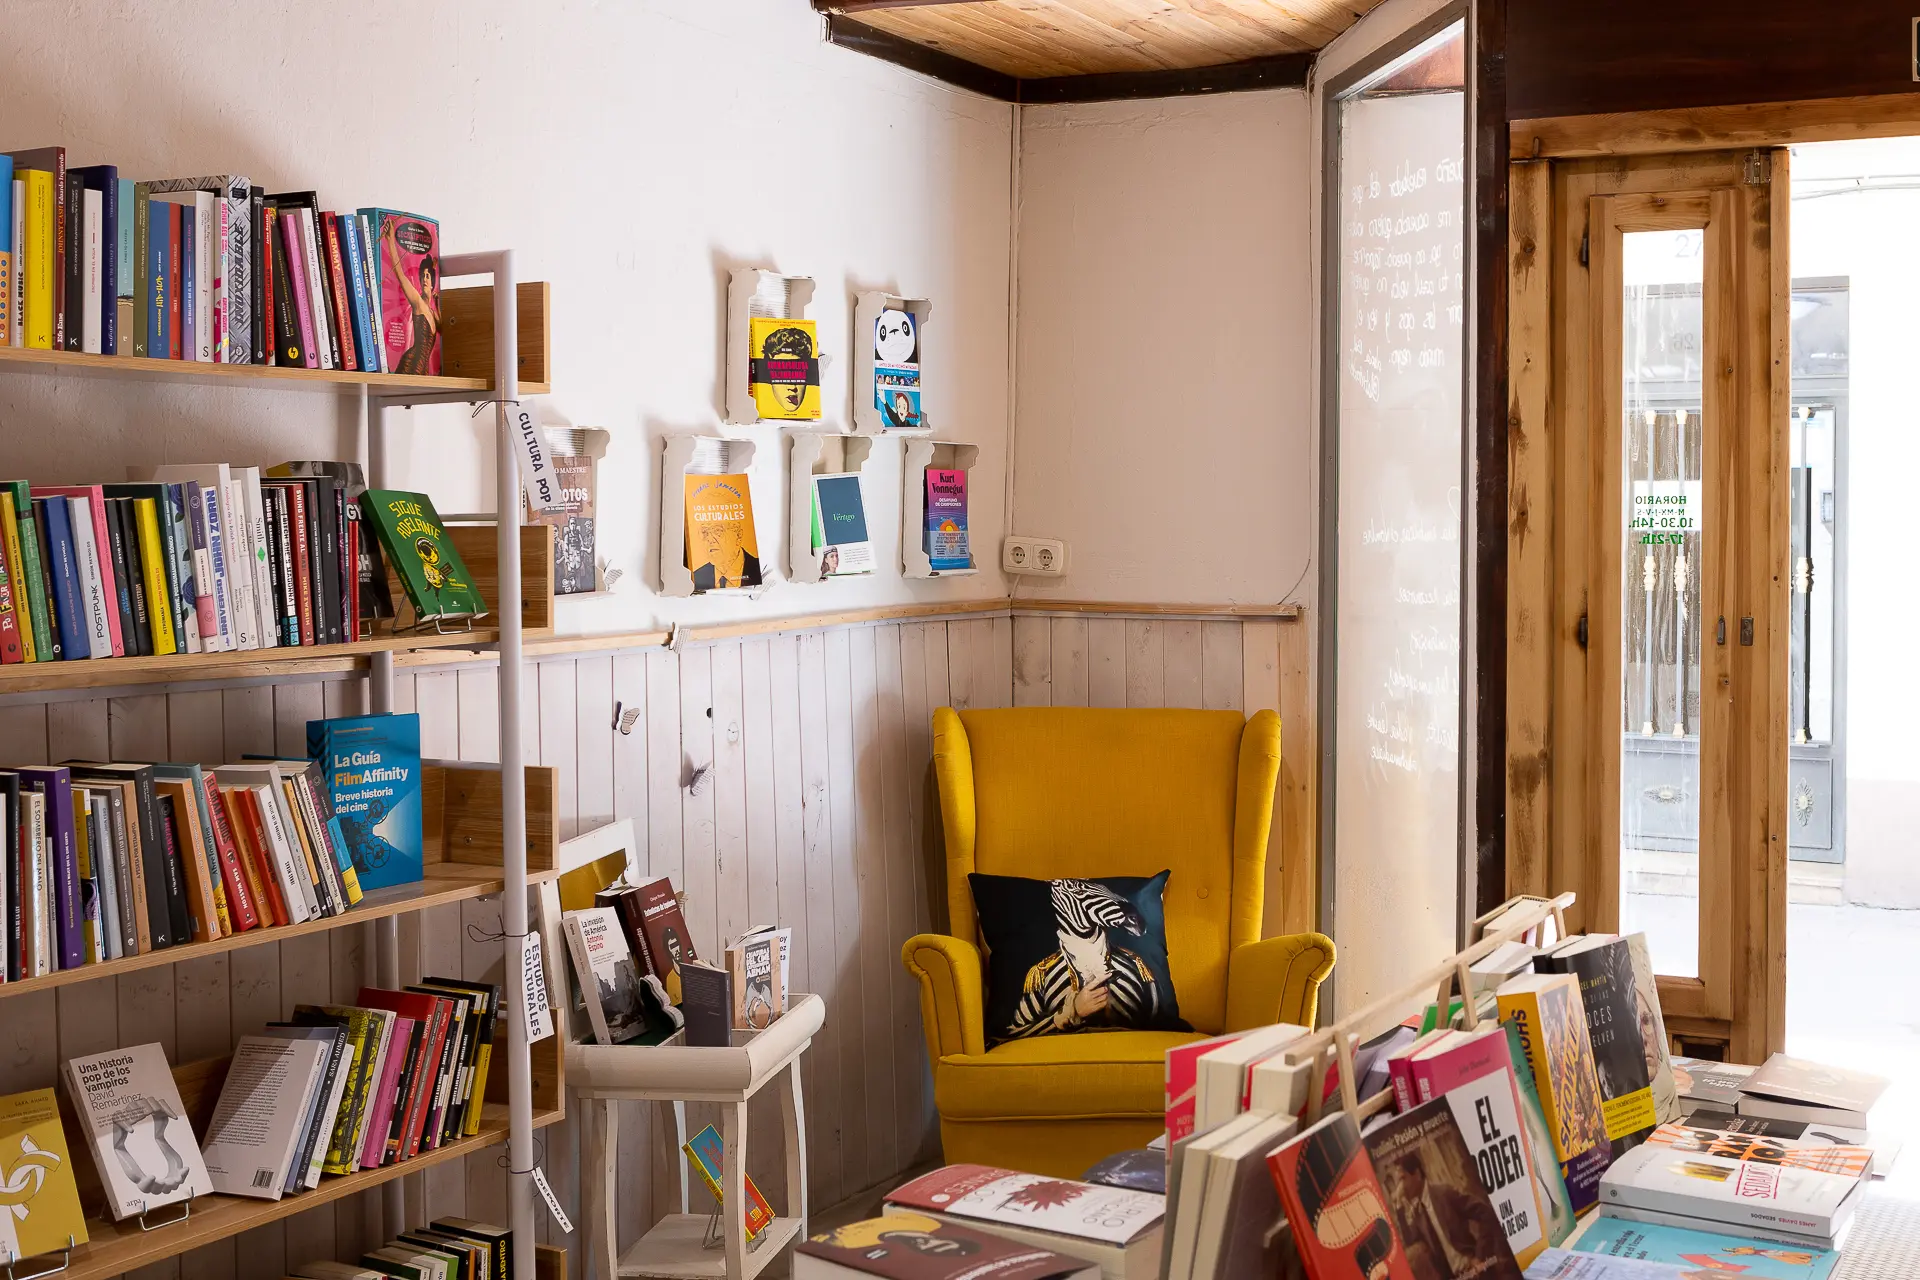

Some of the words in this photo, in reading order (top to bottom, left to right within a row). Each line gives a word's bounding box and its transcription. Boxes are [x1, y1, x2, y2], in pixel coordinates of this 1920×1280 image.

[347, 219, 356, 249] FARGO
[330, 231, 340, 271] LEMMY
[352, 250, 360, 276] ROCK
[234, 222, 244, 325] INOXIDABLE
[354, 276, 364, 299] CITY
[518, 412, 544, 473] CULTURA
[536, 478, 552, 503] POP
[939, 472, 955, 483] Kurt
[932, 482, 964, 496] Vonnegut
[205, 490, 220, 533] ZORN
[388, 500, 423, 518] SIGUE
[694, 511, 745, 522] CULTURALES
[396, 517, 441, 540] ADELANTE
[211, 535, 224, 578] JOHN
[299, 543, 306, 552] AL
[90, 585, 104, 638] POSTPUNK
[214, 578, 228, 636] UNIVERSO
[334, 754, 350, 768] La
[351, 750, 381, 766] Guía
[206, 778, 214, 787] EL
[335, 766, 409, 787] FilmAffinity
[34, 800, 40, 808] EL
[210, 787, 224, 816] GRAN
[335, 792, 360, 803] Breve
[361, 786, 393, 800] historia
[308, 780, 323, 820] SCREAM
[320, 822, 333, 854] QUEER
[335, 803, 349, 814] del
[350, 802, 368, 812] cine
[34, 810, 42, 851] SOMBRERO
[205, 826, 214, 844] ojos
[216, 815, 231, 844] ADIÓS
[208, 845, 216, 857] los
[210, 857, 218, 875] Abre
[236, 882, 248, 910] WASSON
[580, 920, 587, 928] La
[586, 915, 605, 927] invasión
[584, 928, 591, 937] de
[590, 924, 608, 935] América
[158, 934, 165, 943] K
[586, 934, 604, 944] Antonio
[588, 941, 604, 953] Espino
[532, 944, 547, 1013] ESTUDIOS
[524, 948, 542, 1037] CULTURALES
[78, 1063, 98, 1074] Una
[99, 1055, 134, 1071] historia
[328, 1057, 337, 1078] SARA
[334, 1032, 346, 1057] AHMED
[82, 1073, 102, 1085] pop
[102, 1068, 115, 1079] de
[116, 1066, 131, 1076] los
[84, 1076, 129, 1093] vampiros
[88, 1088, 115, 1103] David
[91, 1092, 142, 1112] Remartínez
[316, 1089, 328, 1122] emociones
[1394, 1126, 1419, 1146] Pasión
[1423, 1110, 1449, 1131] muerte
[1474, 1096, 1502, 1144] EL
[126, 1199, 142, 1208] arpa
[536, 1178, 570, 1230] DEPORTE
[1498, 1199, 1514, 1220] UNA
[1506, 1218, 1517, 1236] DE
[1515, 1210, 1529, 1229] USO
[1751, 1212, 1776, 1222] SEDADOS
[1778, 1216, 1798, 1226] DAVIES
[1797, 1219, 1817, 1228] JAMES
